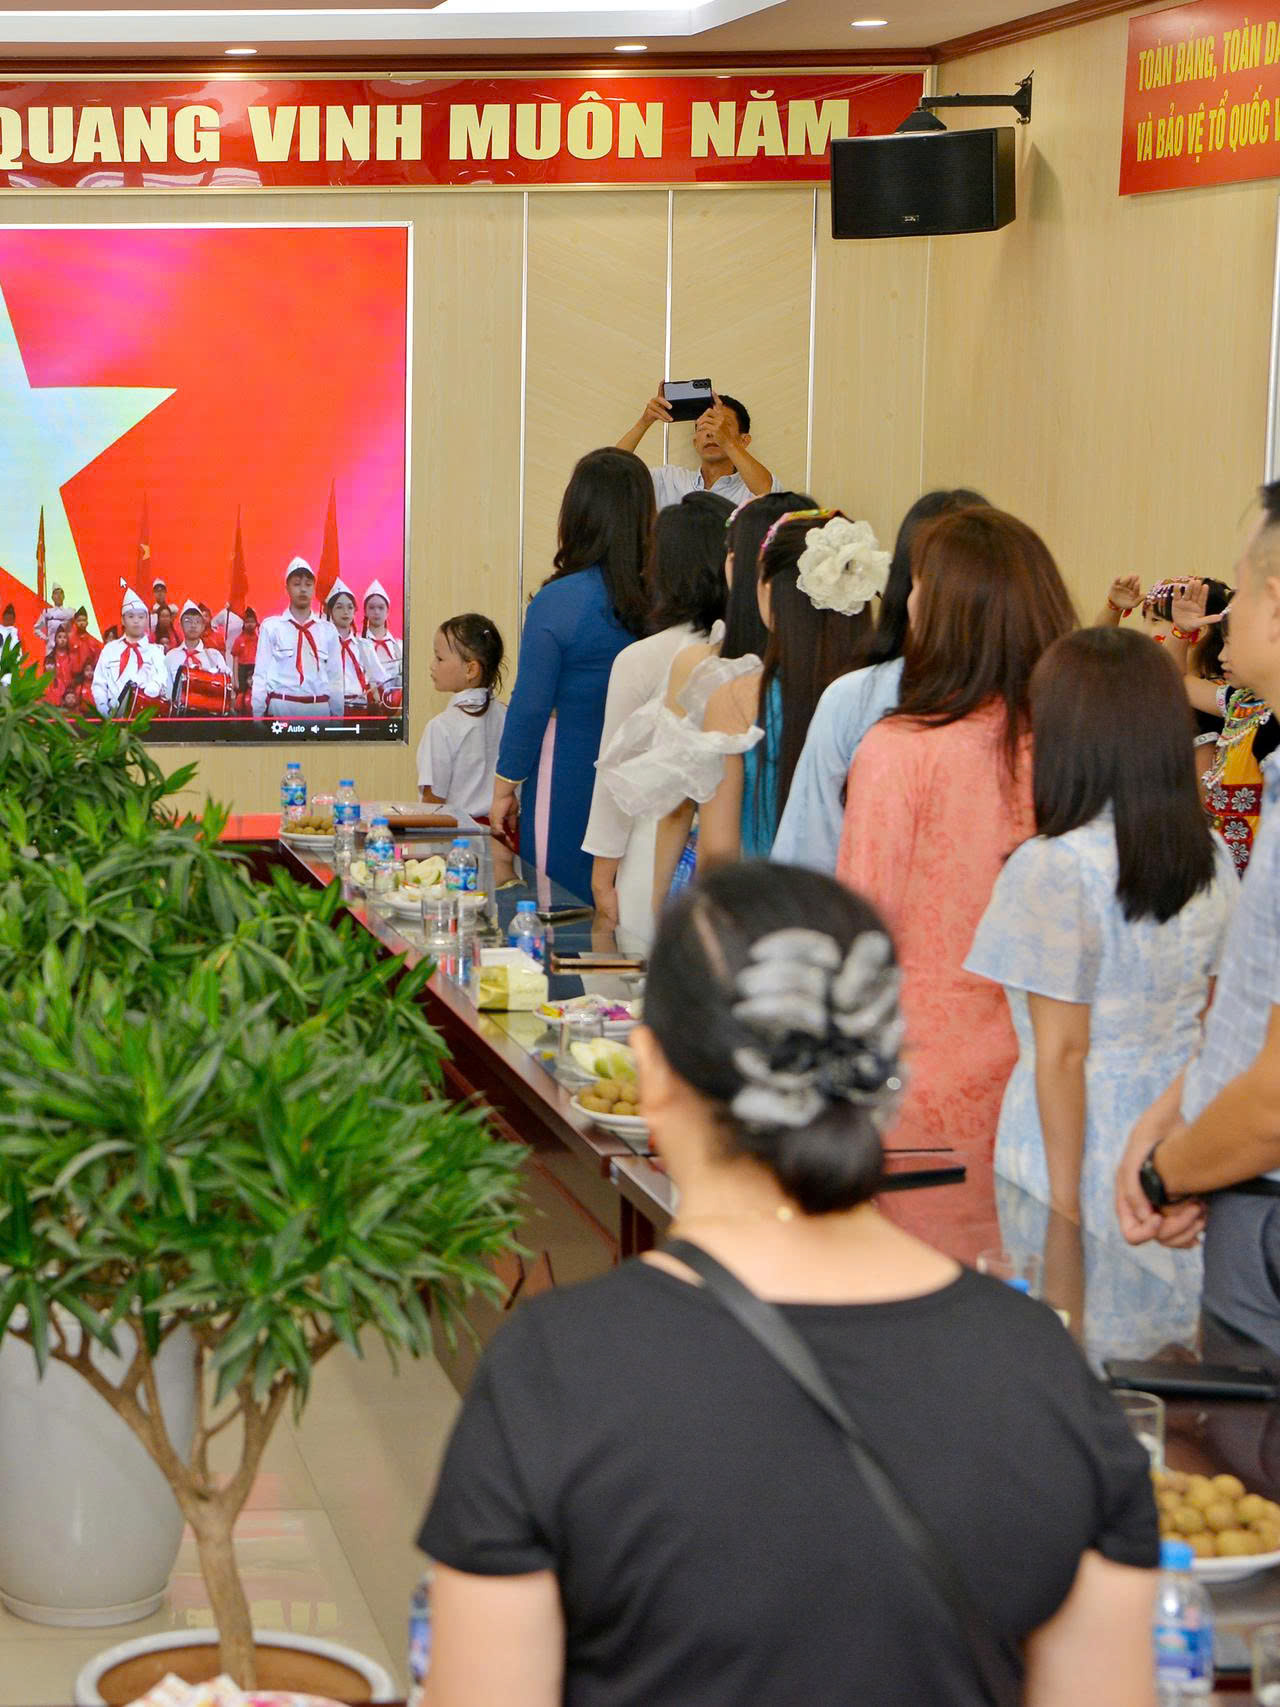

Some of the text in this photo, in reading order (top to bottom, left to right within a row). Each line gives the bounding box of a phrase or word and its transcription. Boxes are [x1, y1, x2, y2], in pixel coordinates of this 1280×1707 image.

[1138, 38, 1174, 91] TOÀN
[1175, 24, 1218, 82] ĐẢNG,
[1223, 17, 1262, 74] TOÀN
[248, 104, 422, 163] VINH
[449, 90, 663, 160] MUÔN
[690, 89, 850, 158] NĂM
[1137, 111, 1153, 162] VÀ
[1156, 102, 1184, 159] BẢO
[1187, 102, 1205, 163] VỆ
[1208, 89, 1229, 152] TỔ
[1229, 84, 1270, 153] QUỐC
